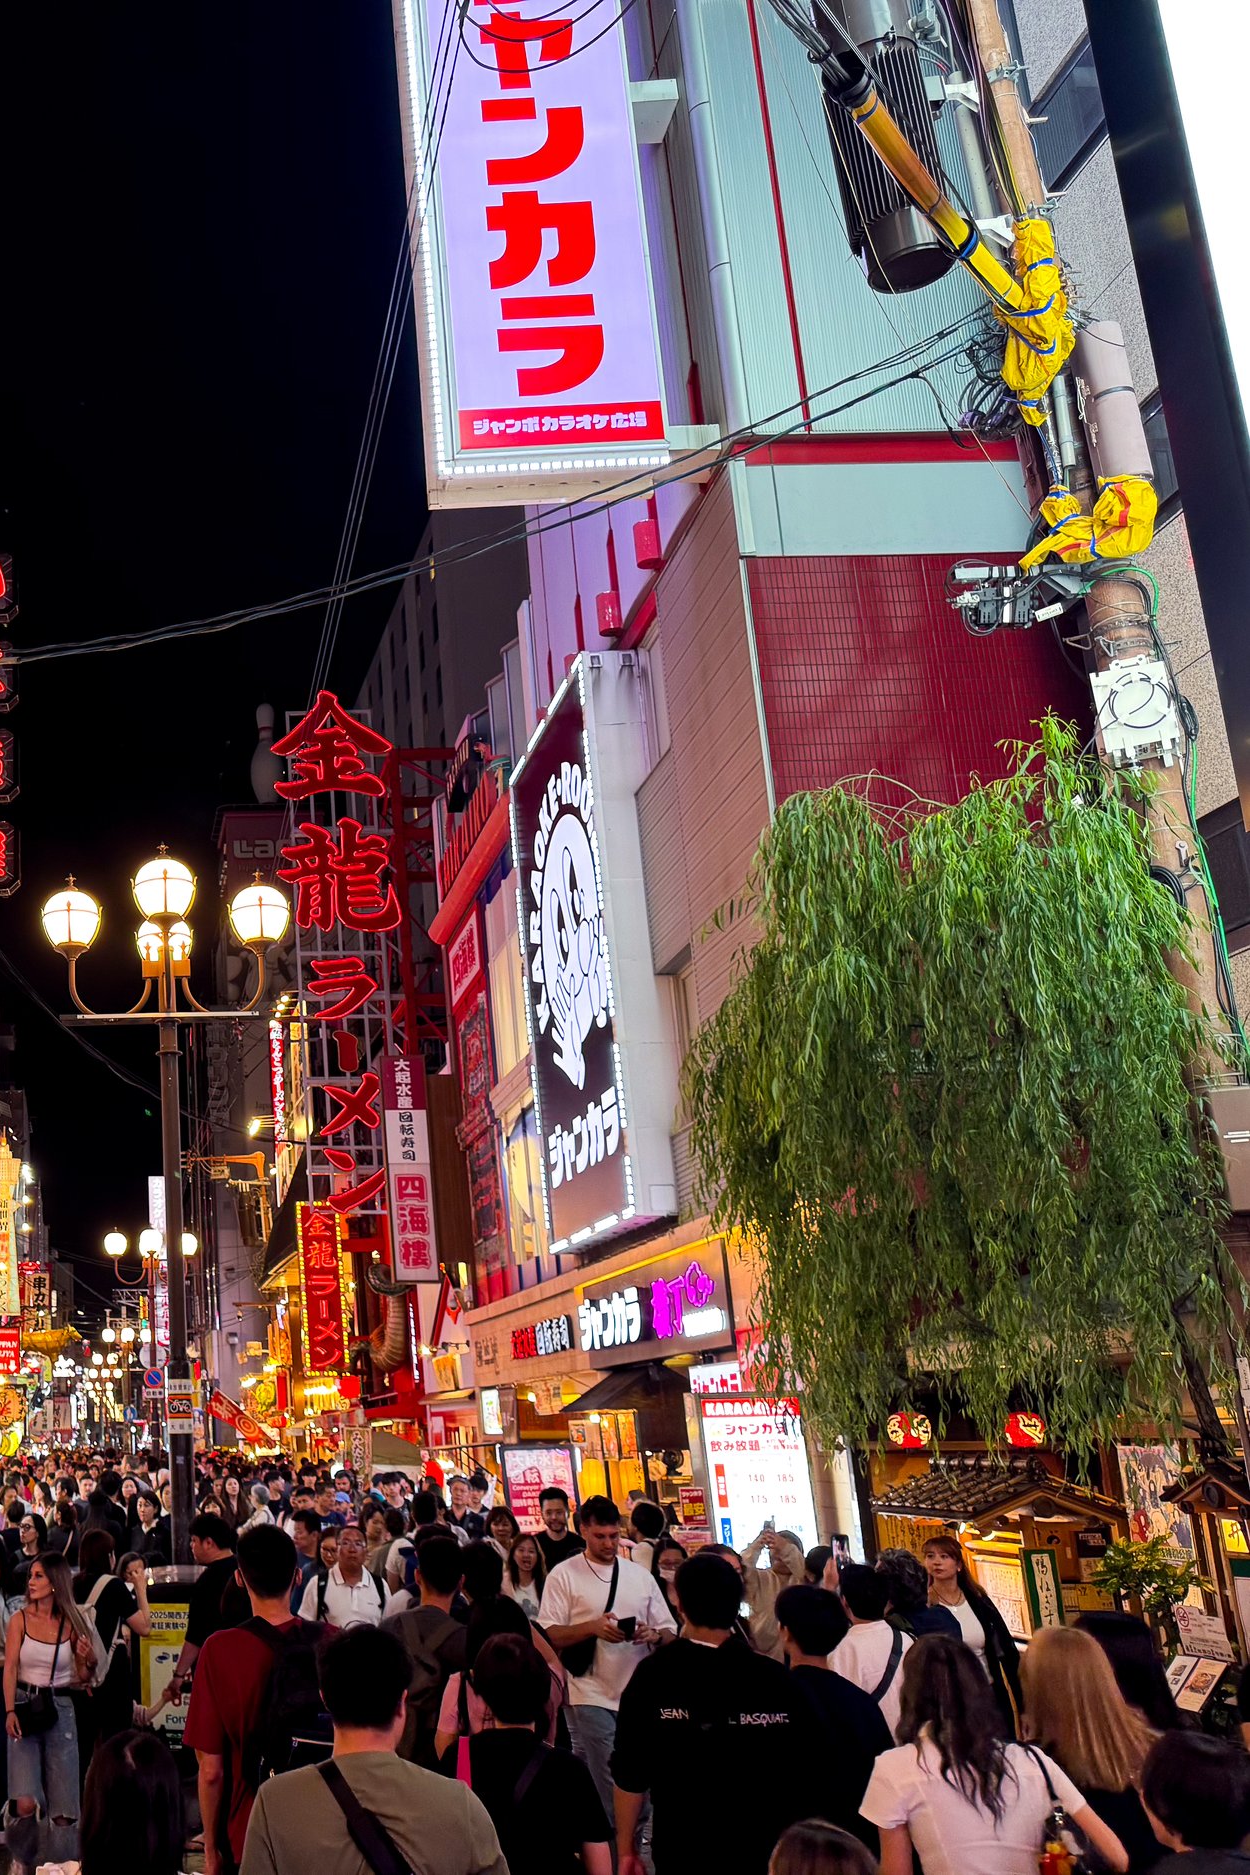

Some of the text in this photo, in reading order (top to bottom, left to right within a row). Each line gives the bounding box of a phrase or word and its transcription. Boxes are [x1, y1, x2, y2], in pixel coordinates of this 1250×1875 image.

[474, 0, 605, 397] ャンカラ
[473, 411, 647, 435] ジャンボカラオケ広場
[270, 690, 404, 1215] 金龍ラーメン
[394, 1059, 414, 1109] 大起水産
[398, 1111, 416, 1162] 回転寿司
[549, 1086, 620, 1189] ジャンカラ
[394, 1174, 432, 1269] 四海樓
[304, 1210, 343, 1368] 金龍ラーメン
[577, 1286, 642, 1352] ジャンカラ
[710, 1440, 761, 1452] 飲み放題
[777, 1474, 794, 1482] 185
[780, 1495, 797, 1503] 185
[660, 1708, 689, 1719] JEAN
